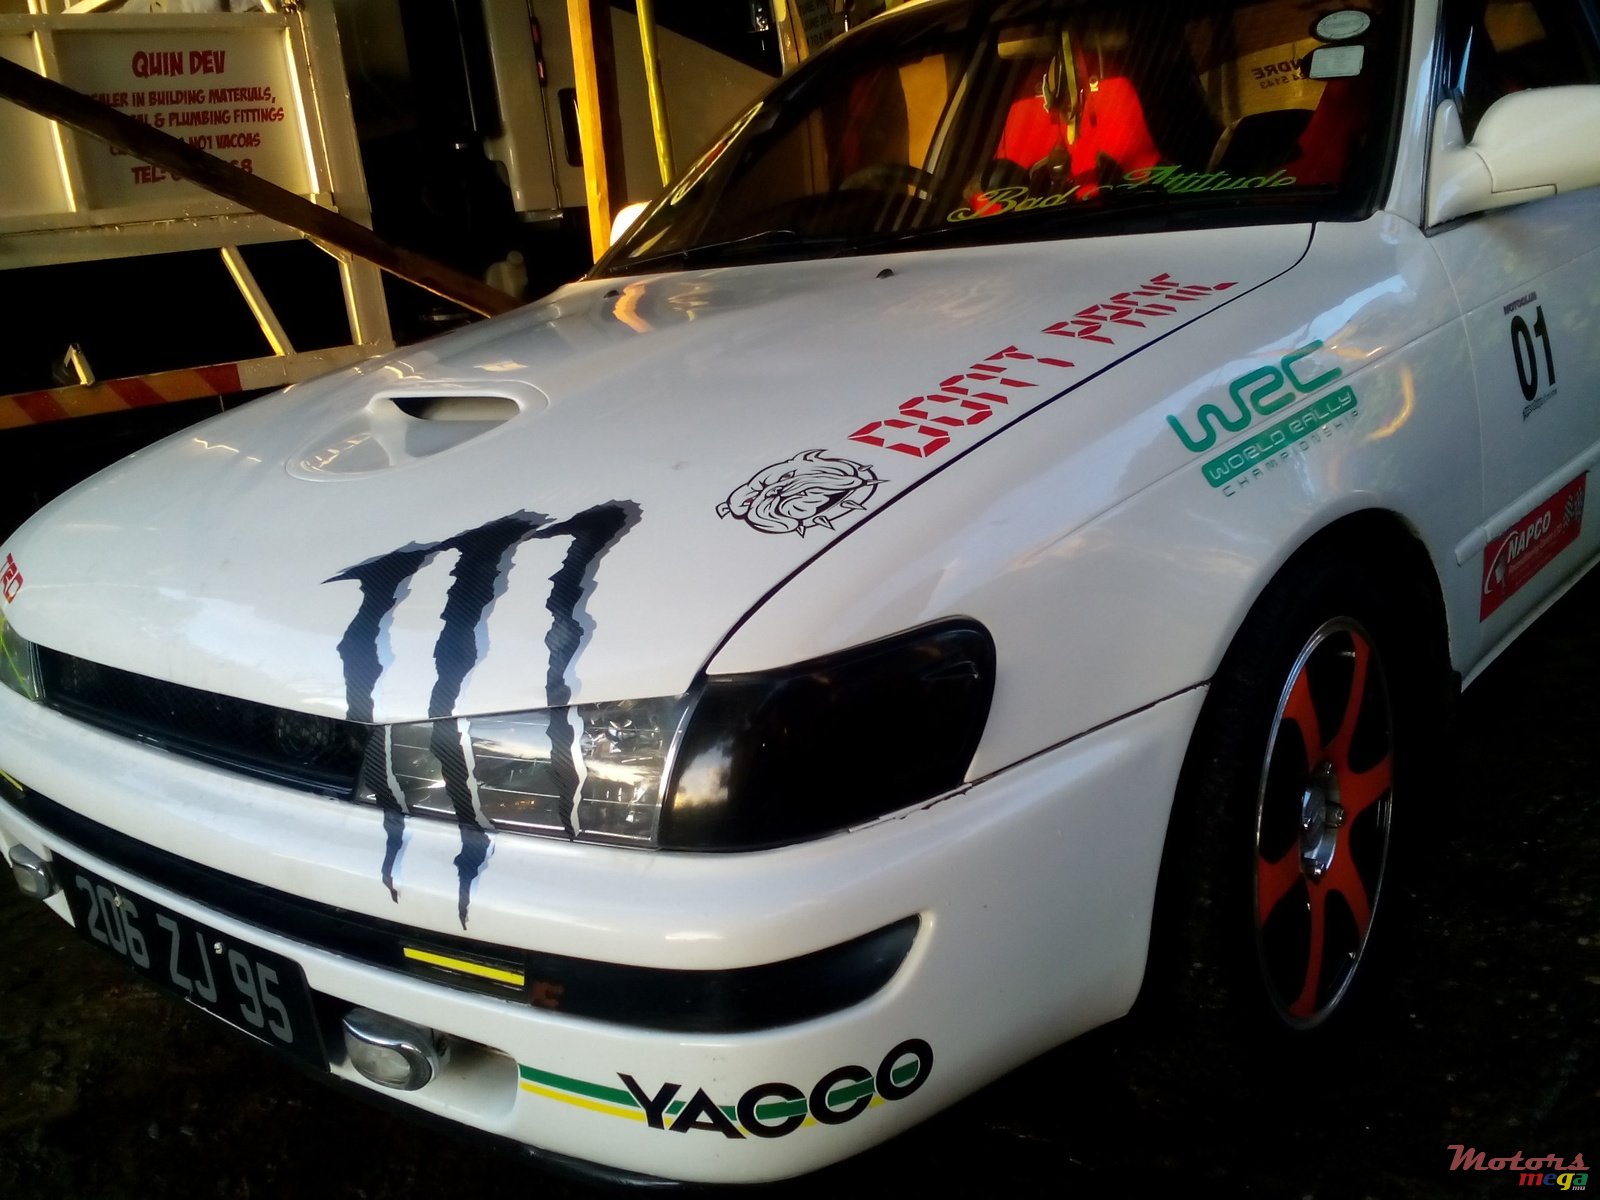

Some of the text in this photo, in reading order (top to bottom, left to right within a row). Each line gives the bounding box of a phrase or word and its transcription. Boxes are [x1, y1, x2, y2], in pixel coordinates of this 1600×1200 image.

[131, 50, 225, 78] QUIN DEV
[132, 91, 145, 107] IN
[149, 89, 205, 107] BUILDING
[208, 86, 276, 104] MATERIALS,
[154, 112, 166, 128] &
[168, 110, 231, 127] PLUMBING
[233, 107, 284, 123] FITTINGS
[947, 186, 1081, 223] Bad
[1100, 163, 1297, 195] Attitude
[1041, 272, 1239, 345] PANIC
[1510, 304, 1556, 402] 01
[1166, 338, 1343, 453] WRC
[1208, 390, 1353, 481] WORLD RALLY
[1506, 510, 1552, 564] NAPCO
[75, 874, 294, 1044] 206 ZJ 95
[617, 1038, 934, 1139] YACCO
